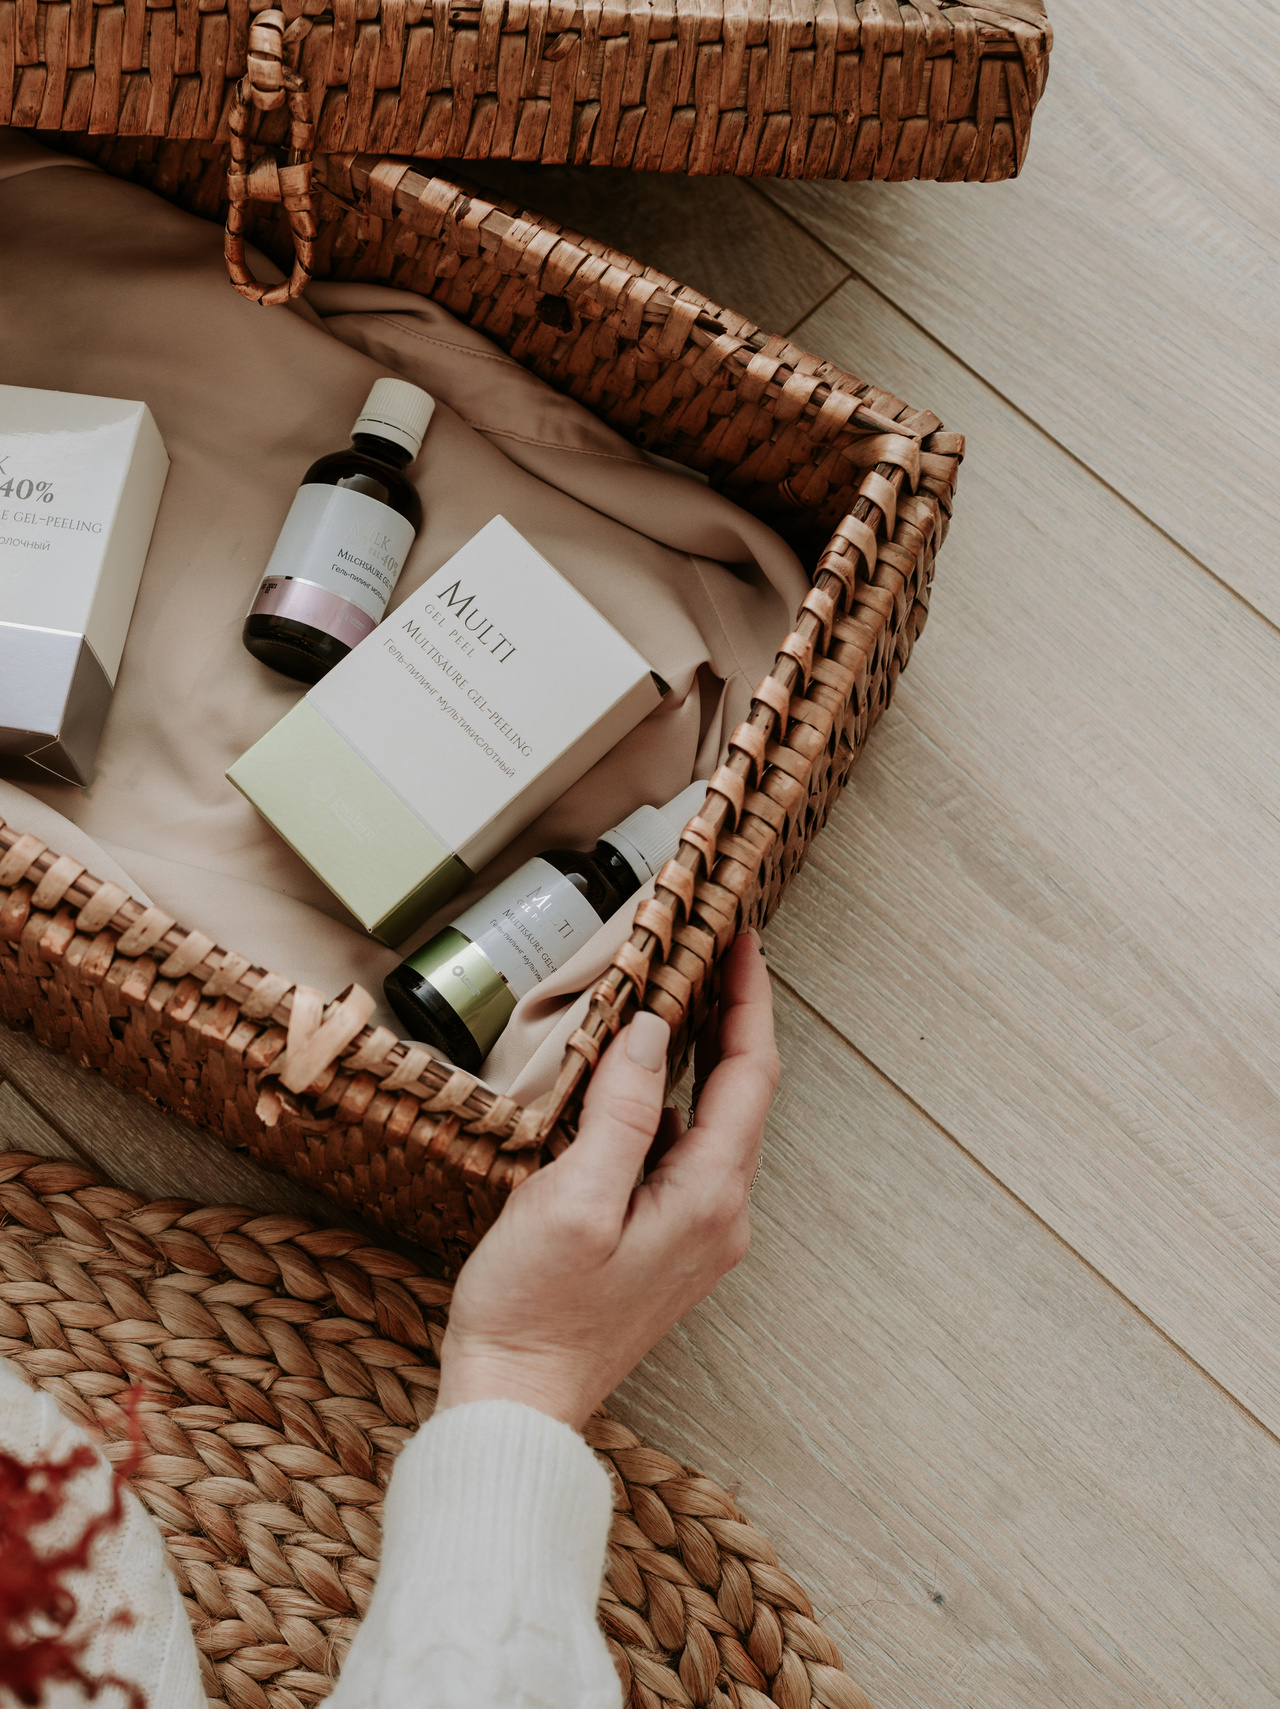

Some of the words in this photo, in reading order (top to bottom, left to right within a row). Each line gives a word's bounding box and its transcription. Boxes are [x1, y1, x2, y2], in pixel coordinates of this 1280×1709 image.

[13, 511, 103, 534] GEL-PEELING
[331, 563, 372, 590] Гель-пилинг
[424, 604, 446, 628] GEL
[449, 629, 475, 658] PEEL
[436, 579, 517, 664] MULTI
[383, 638, 439, 696] Гель-пилинг
[436, 696, 515, 779] мультикислотный
[402, 619, 469, 690] MULTISÄURE
[467, 689, 533, 757] GEL-PEELING
[489, 918, 524, 955] Гель-пилинг
[502, 908, 543, 953] MULTISÄURE
